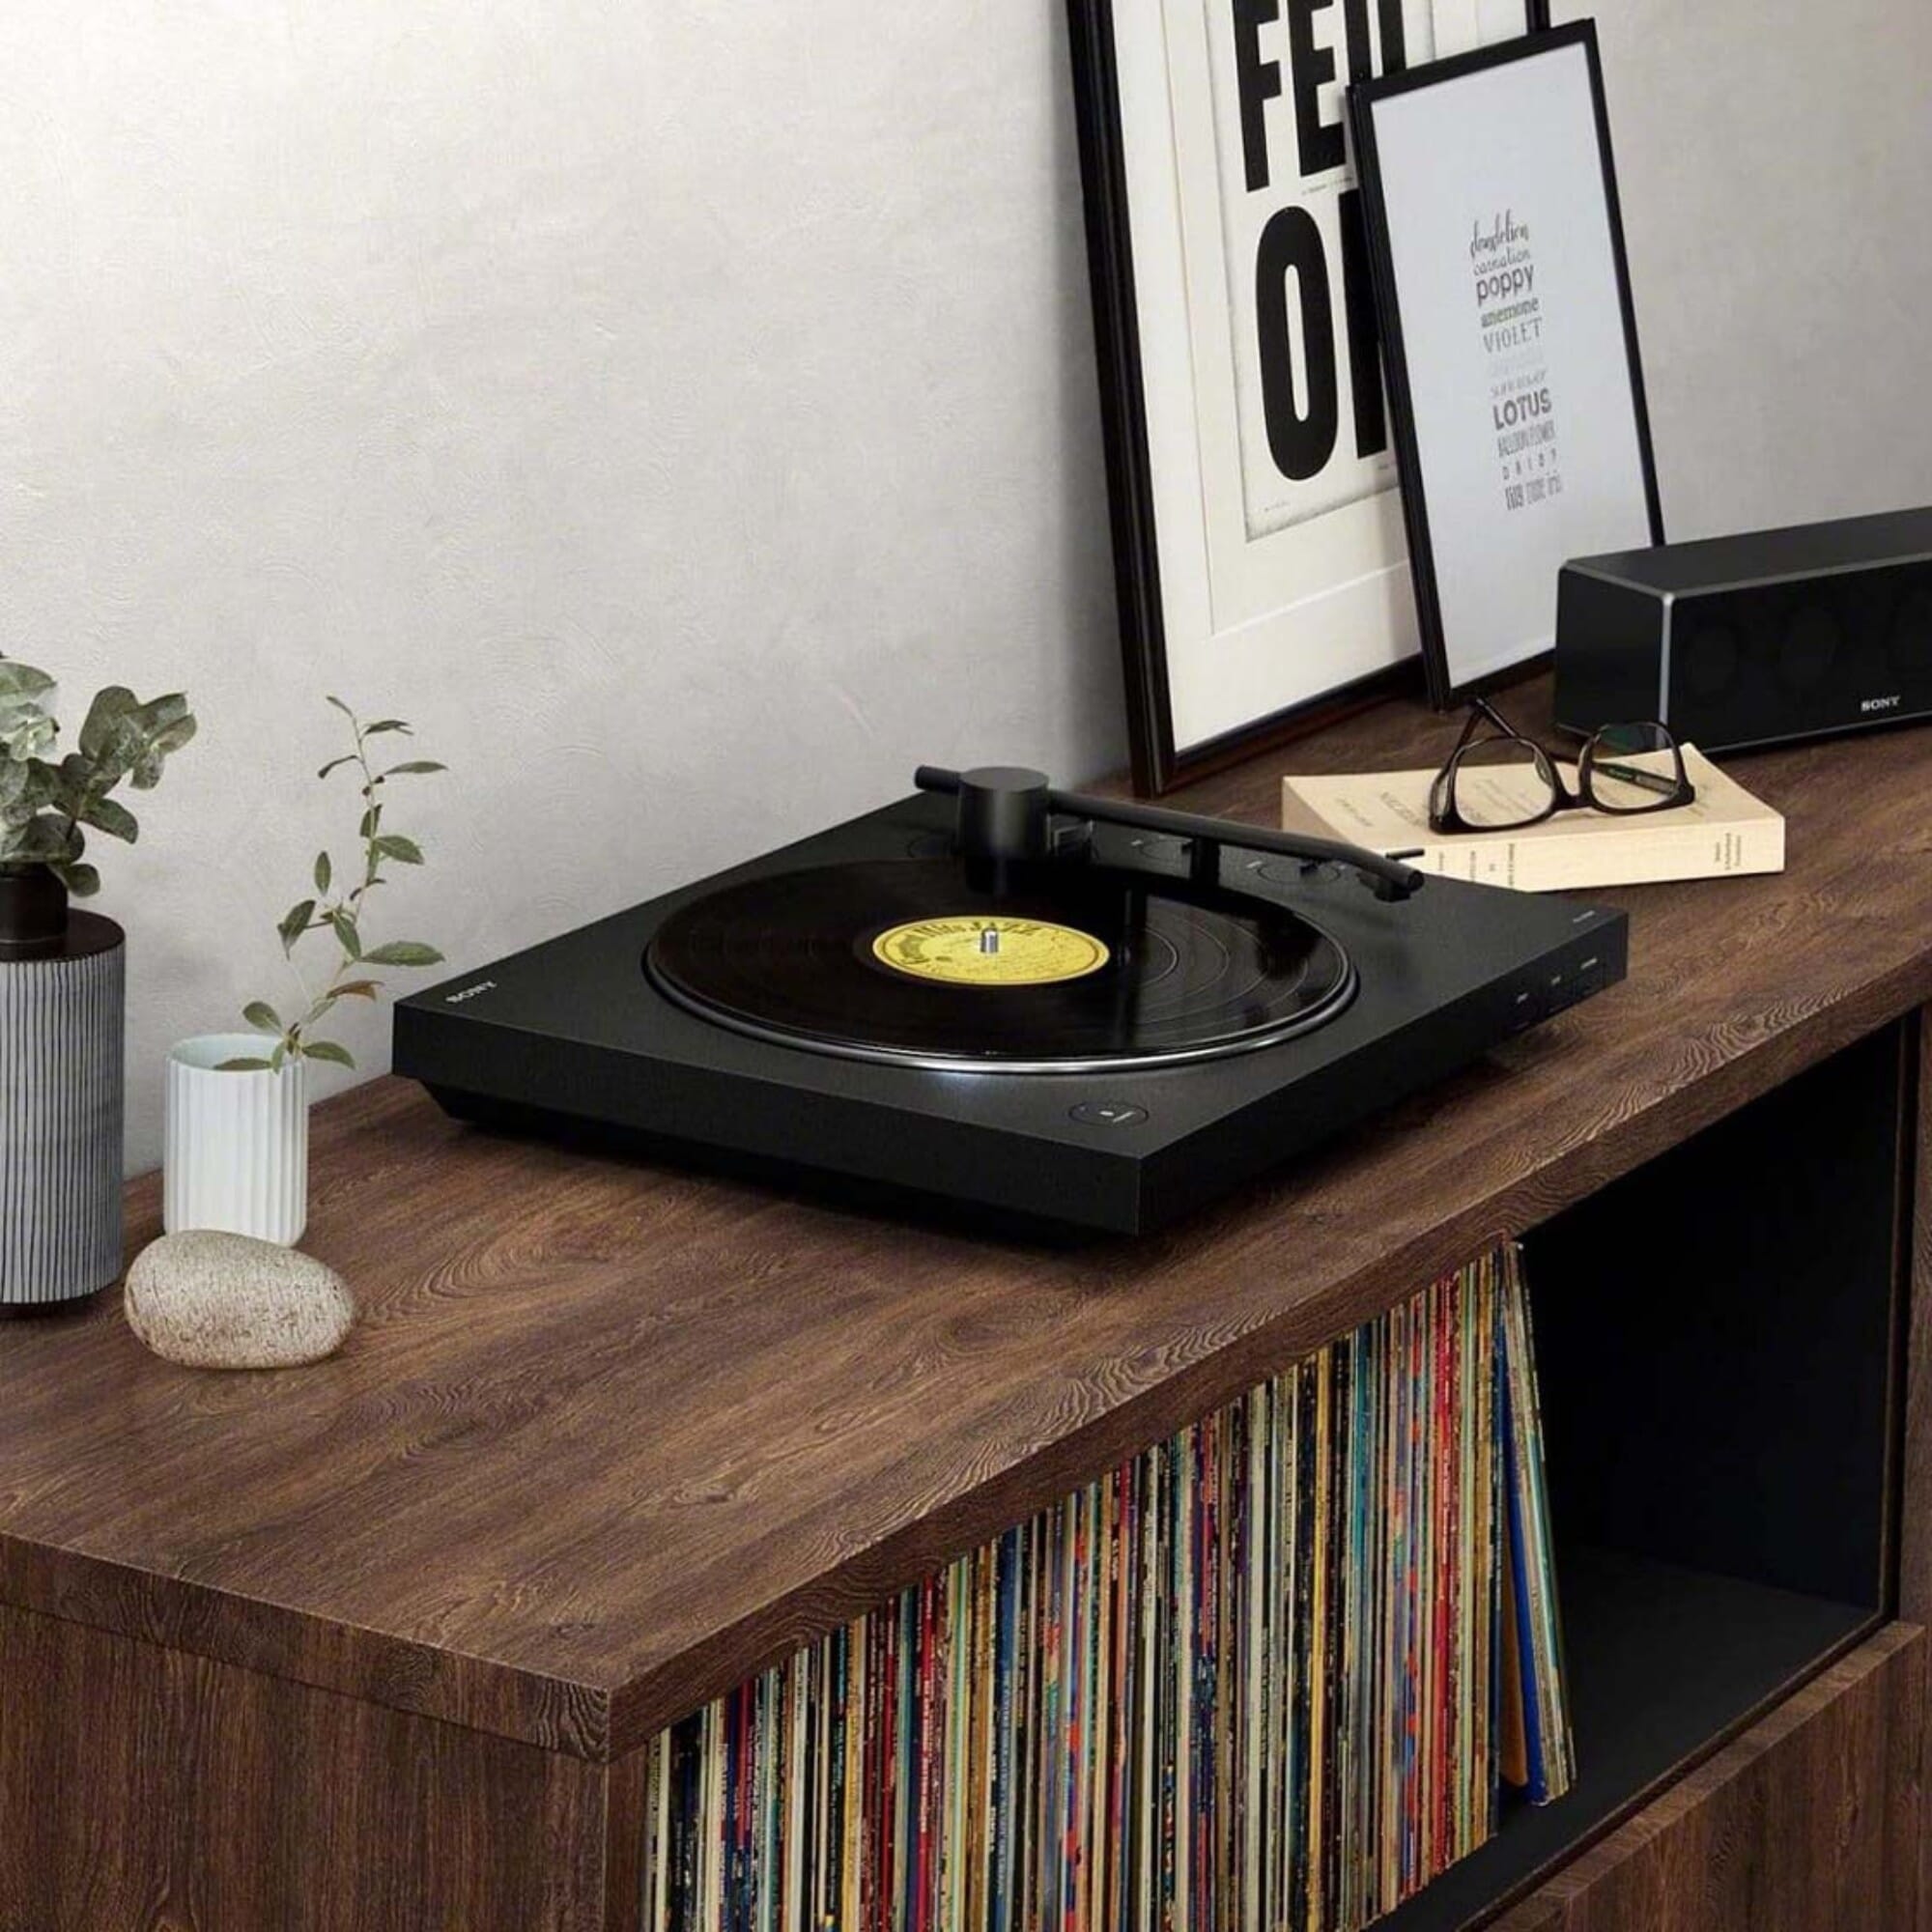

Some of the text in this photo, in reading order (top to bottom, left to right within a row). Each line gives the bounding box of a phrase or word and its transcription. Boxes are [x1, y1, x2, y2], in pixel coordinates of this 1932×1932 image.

[1476, 264, 1534, 307] poppy
[1481, 298, 1539, 328] anemone
[1483, 316, 1543, 353] VIOLET
[1492, 387, 1552, 431] LOTUS
[1860, 695, 1901, 712] SONY
